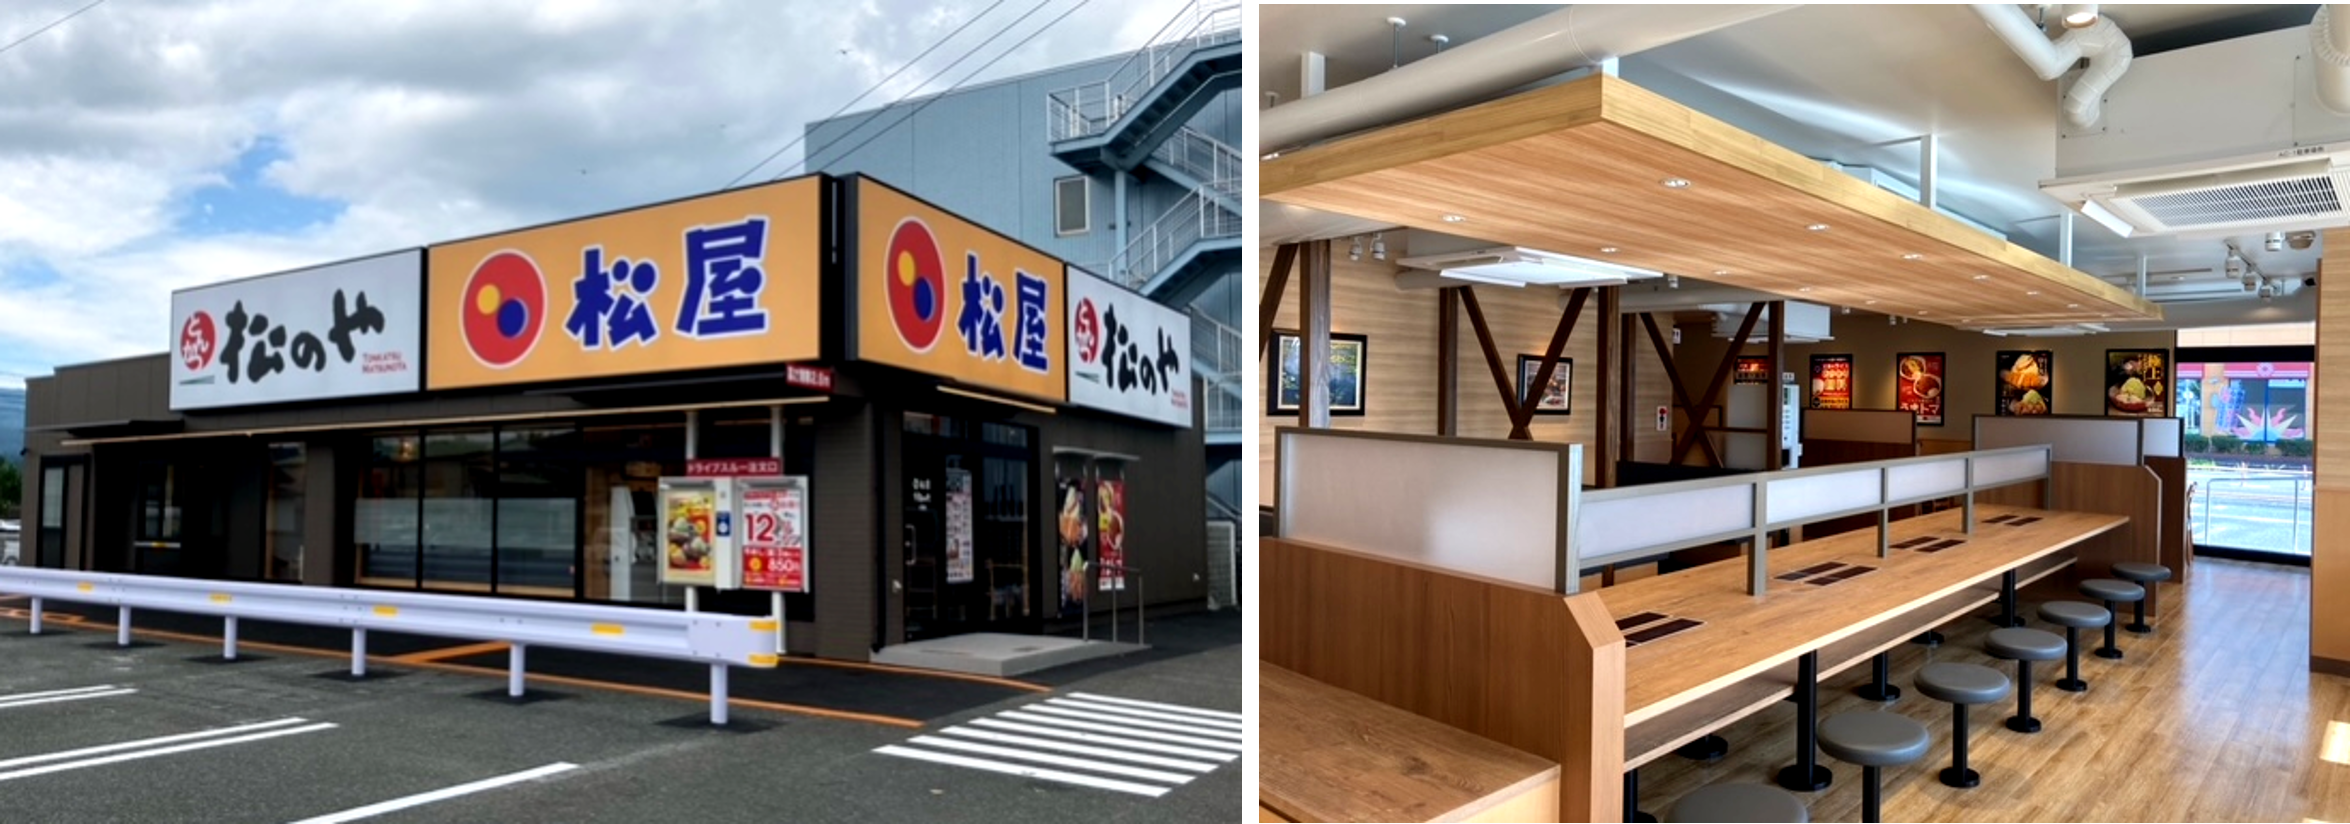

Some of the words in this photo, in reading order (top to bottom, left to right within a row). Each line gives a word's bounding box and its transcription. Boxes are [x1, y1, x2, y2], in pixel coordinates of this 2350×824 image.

[563, 215, 768, 348] 松屋
[956, 250, 1049, 373] 松屋
[219, 288, 385, 385] 松のや
[1102, 302, 1179, 395] 松のや
[745, 513, 774, 542] 12
